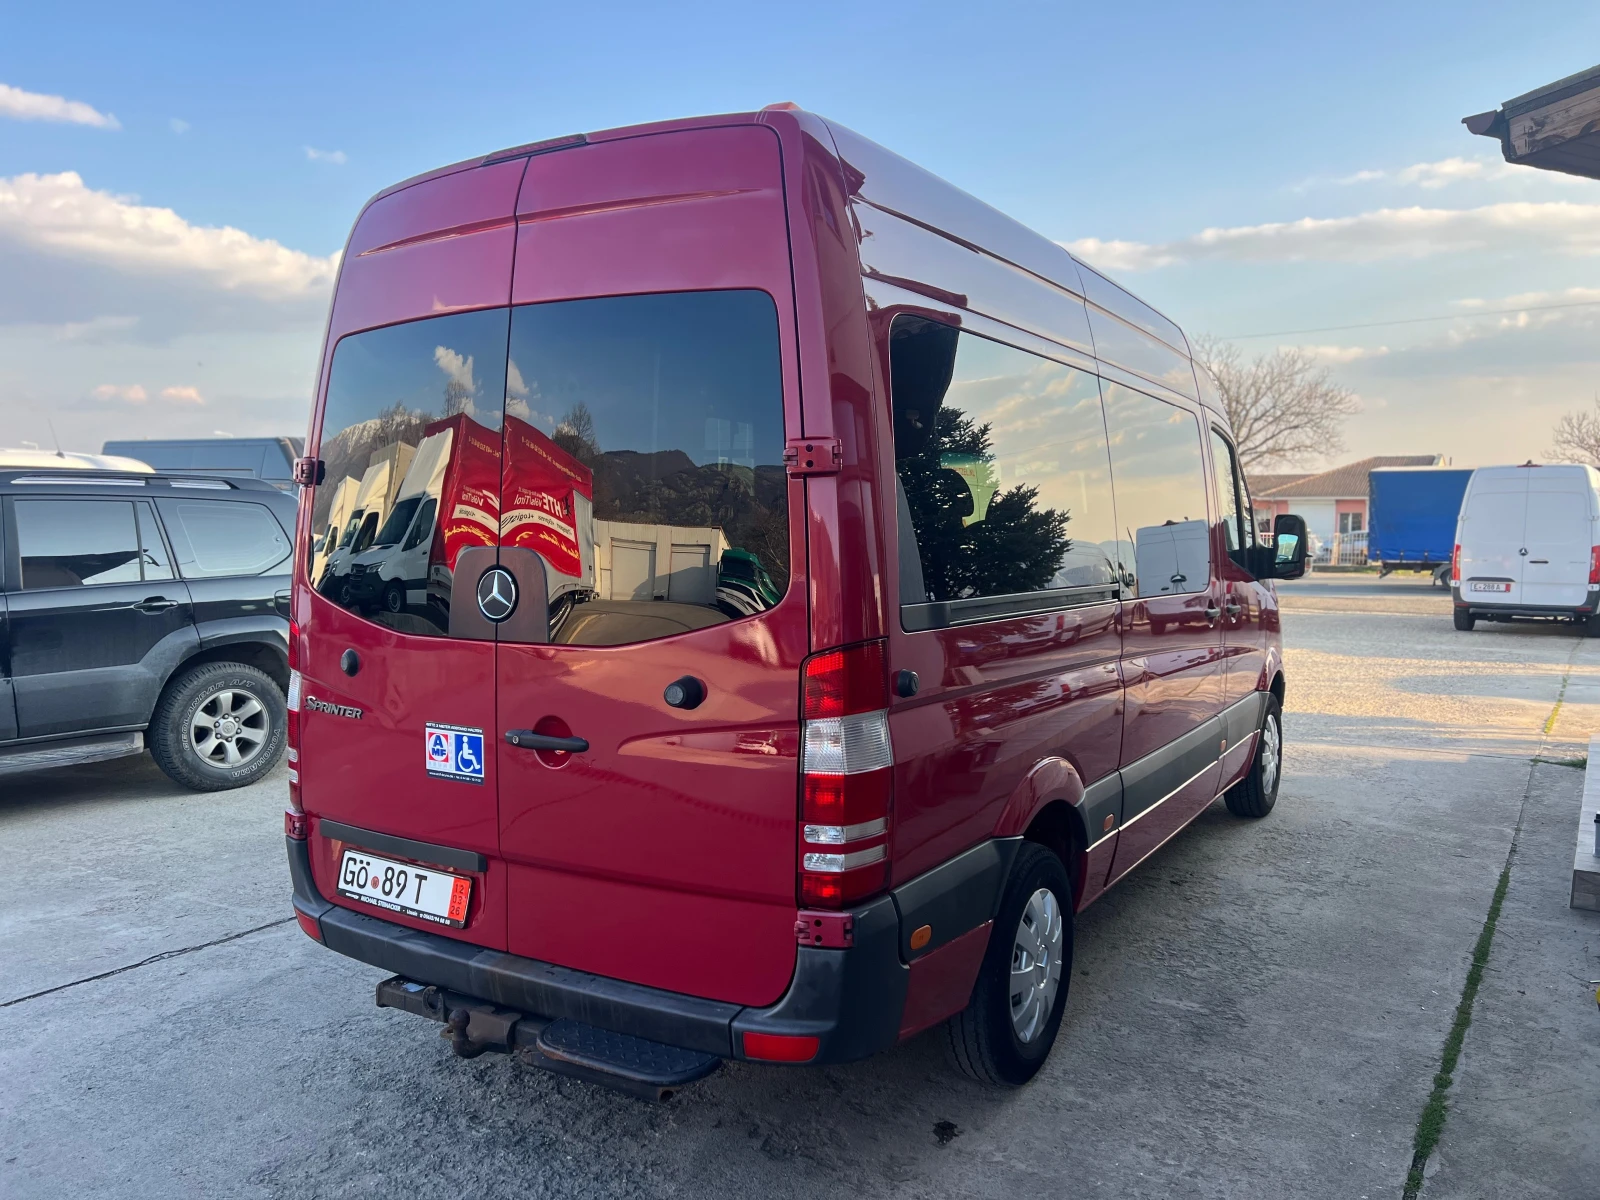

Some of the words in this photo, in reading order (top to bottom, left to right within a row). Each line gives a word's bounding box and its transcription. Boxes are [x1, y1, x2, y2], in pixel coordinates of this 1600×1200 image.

[229, 678, 256, 688] A/T
[180, 681, 225, 751] GEOLANDAR
[231, 728, 281, 778] YOKOHAMA
[343, 856, 371, 889] GÖ
[381, 866, 408, 899] 89
[414, 873, 428, 905] T
[454, 883, 465, 894] 12
[452, 894, 463, 904] 03
[450, 905, 461, 915] 26
